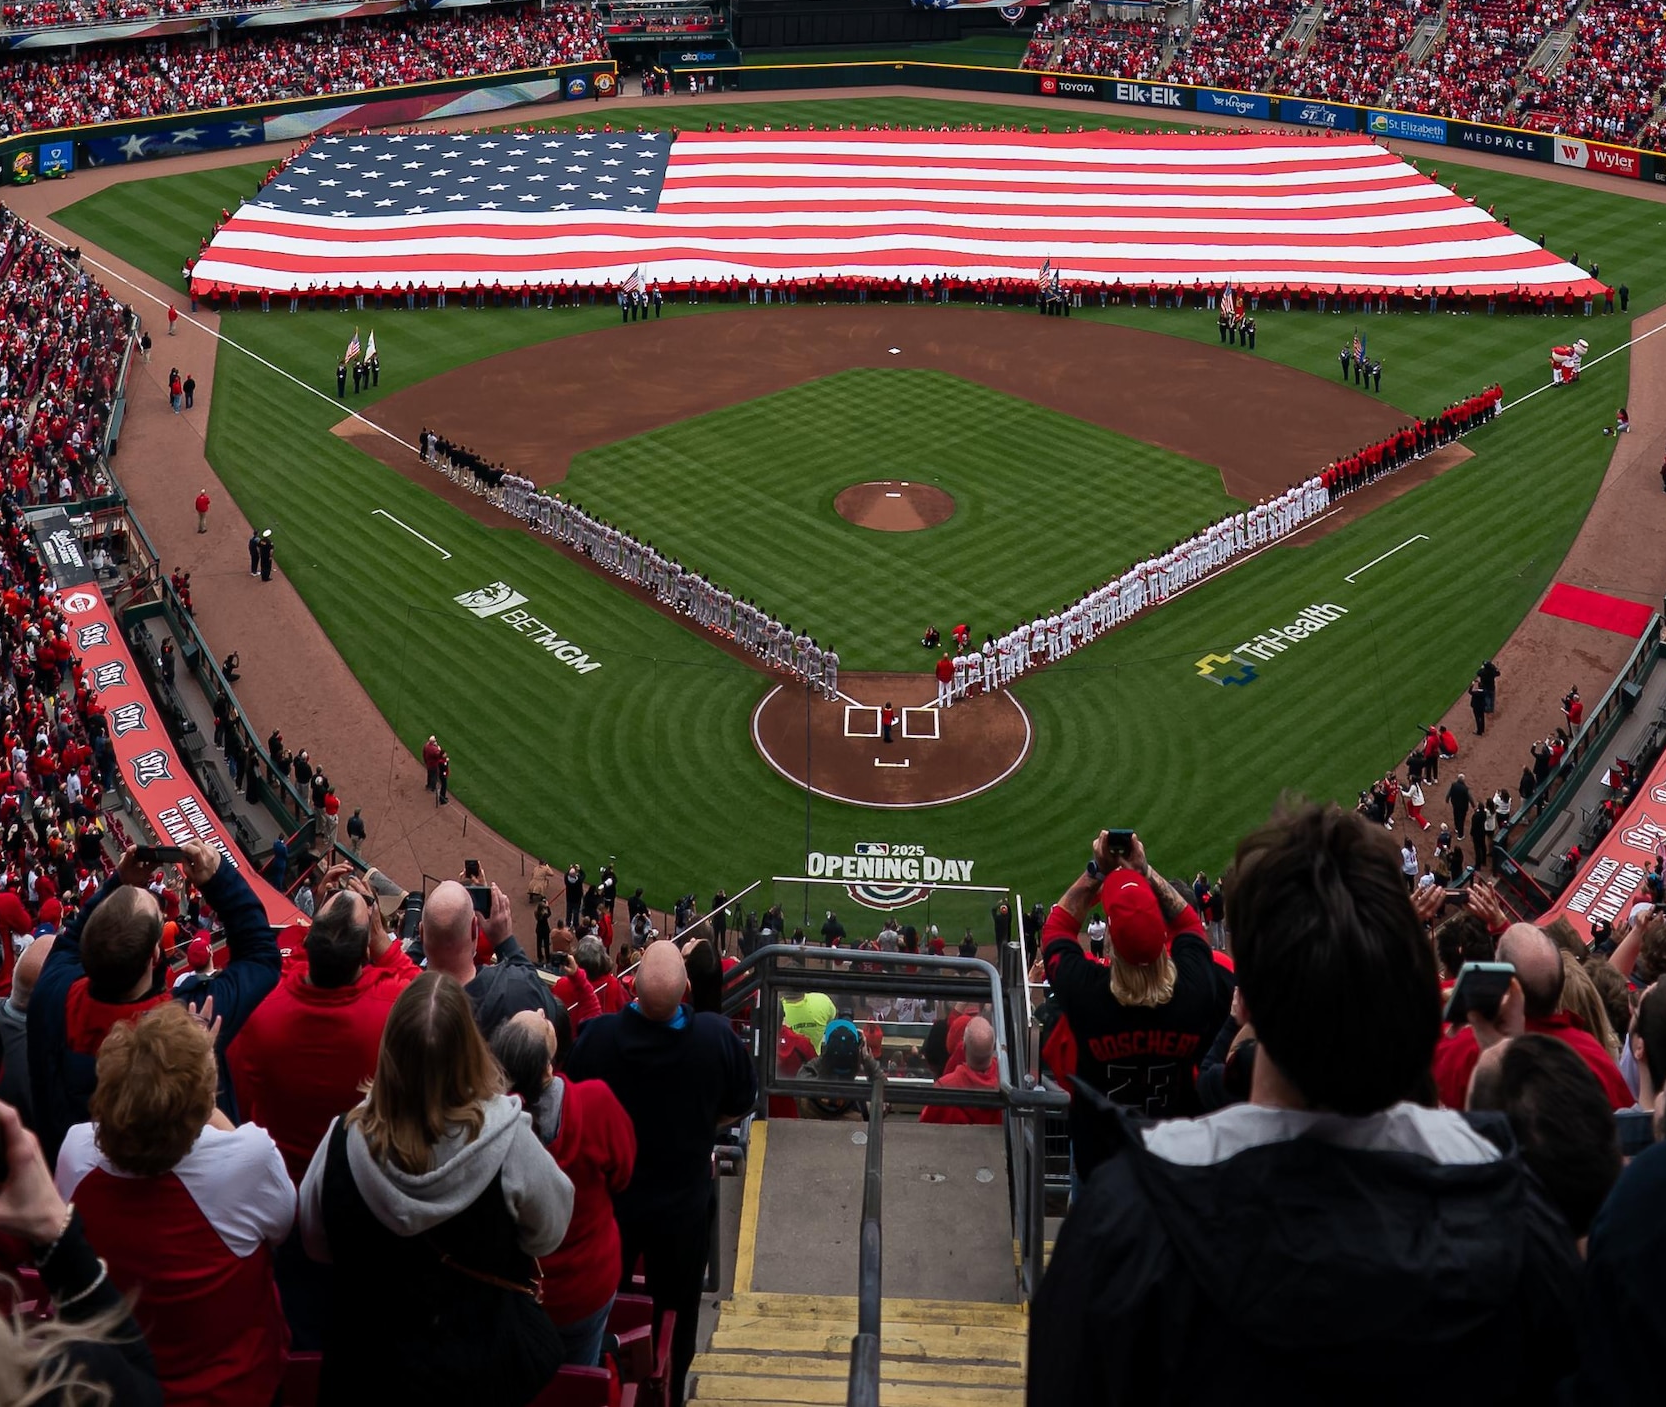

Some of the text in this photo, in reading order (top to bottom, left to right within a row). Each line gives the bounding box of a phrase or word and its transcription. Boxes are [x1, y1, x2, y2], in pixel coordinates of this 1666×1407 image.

[1059, 82, 1095, 93] TOYOTA
[1389, 118, 1444, 136] St. Elizabeth
[1463, 131, 1535, 151] MEDPACE
[1594, 149, 1635, 169] Wyler
[81, 622, 104, 646] 1939
[500, 608, 602, 675] BETMGM
[1233, 602, 1349, 661] TriHealth
[98, 661, 121, 686] 1961
[116, 703, 138, 731] 1970
[136, 751, 166, 781] 1972
[177, 795, 215, 839] NATIONAL
[891, 844, 926, 857] 2025
[807, 851, 975, 882] OPENING DAY
[1566, 856, 1620, 914] WORLD SERIES
